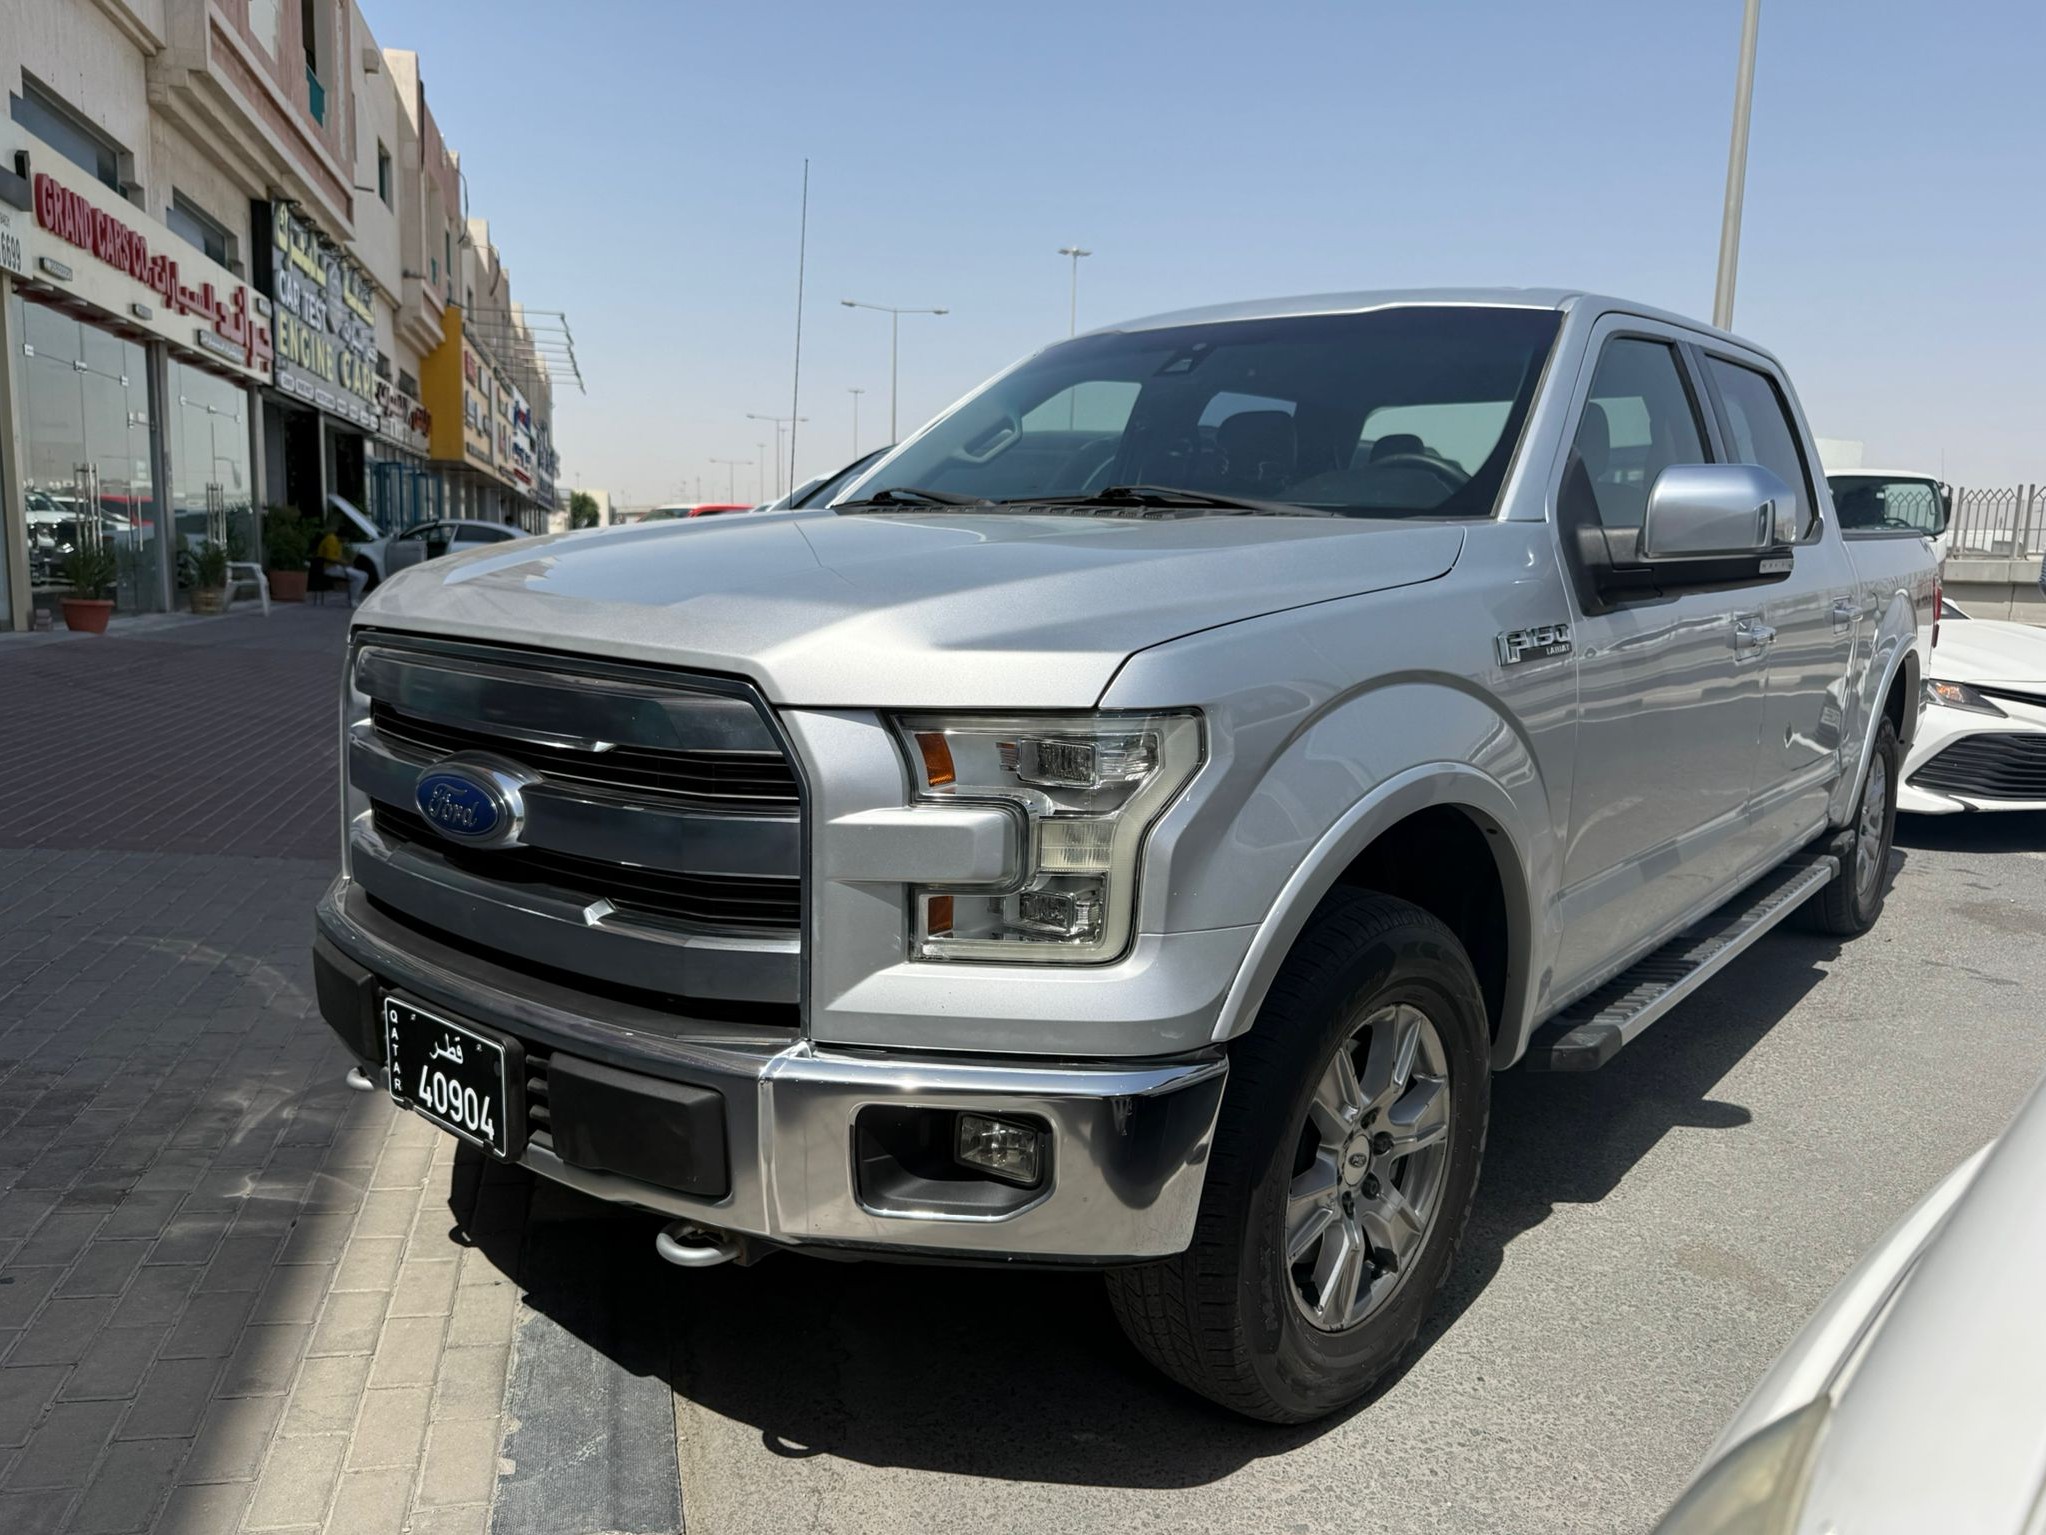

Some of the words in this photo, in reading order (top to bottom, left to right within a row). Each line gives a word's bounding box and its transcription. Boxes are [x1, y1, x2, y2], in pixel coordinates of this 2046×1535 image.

[35, 173, 93, 250] GRAND
[91, 207, 130, 271] CARS
[279, 269, 300, 315] CAR
[301, 289, 327, 334] TEST
[277, 308, 334, 383] ENGINE
[1546, 644, 1570, 656] LARIAT
[428, 783, 480, 828] Ford
[389, 1009, 403, 1092] QATAR
[429, 1033, 464, 1065] قطر
[418, 1065, 495, 1142] 40904
